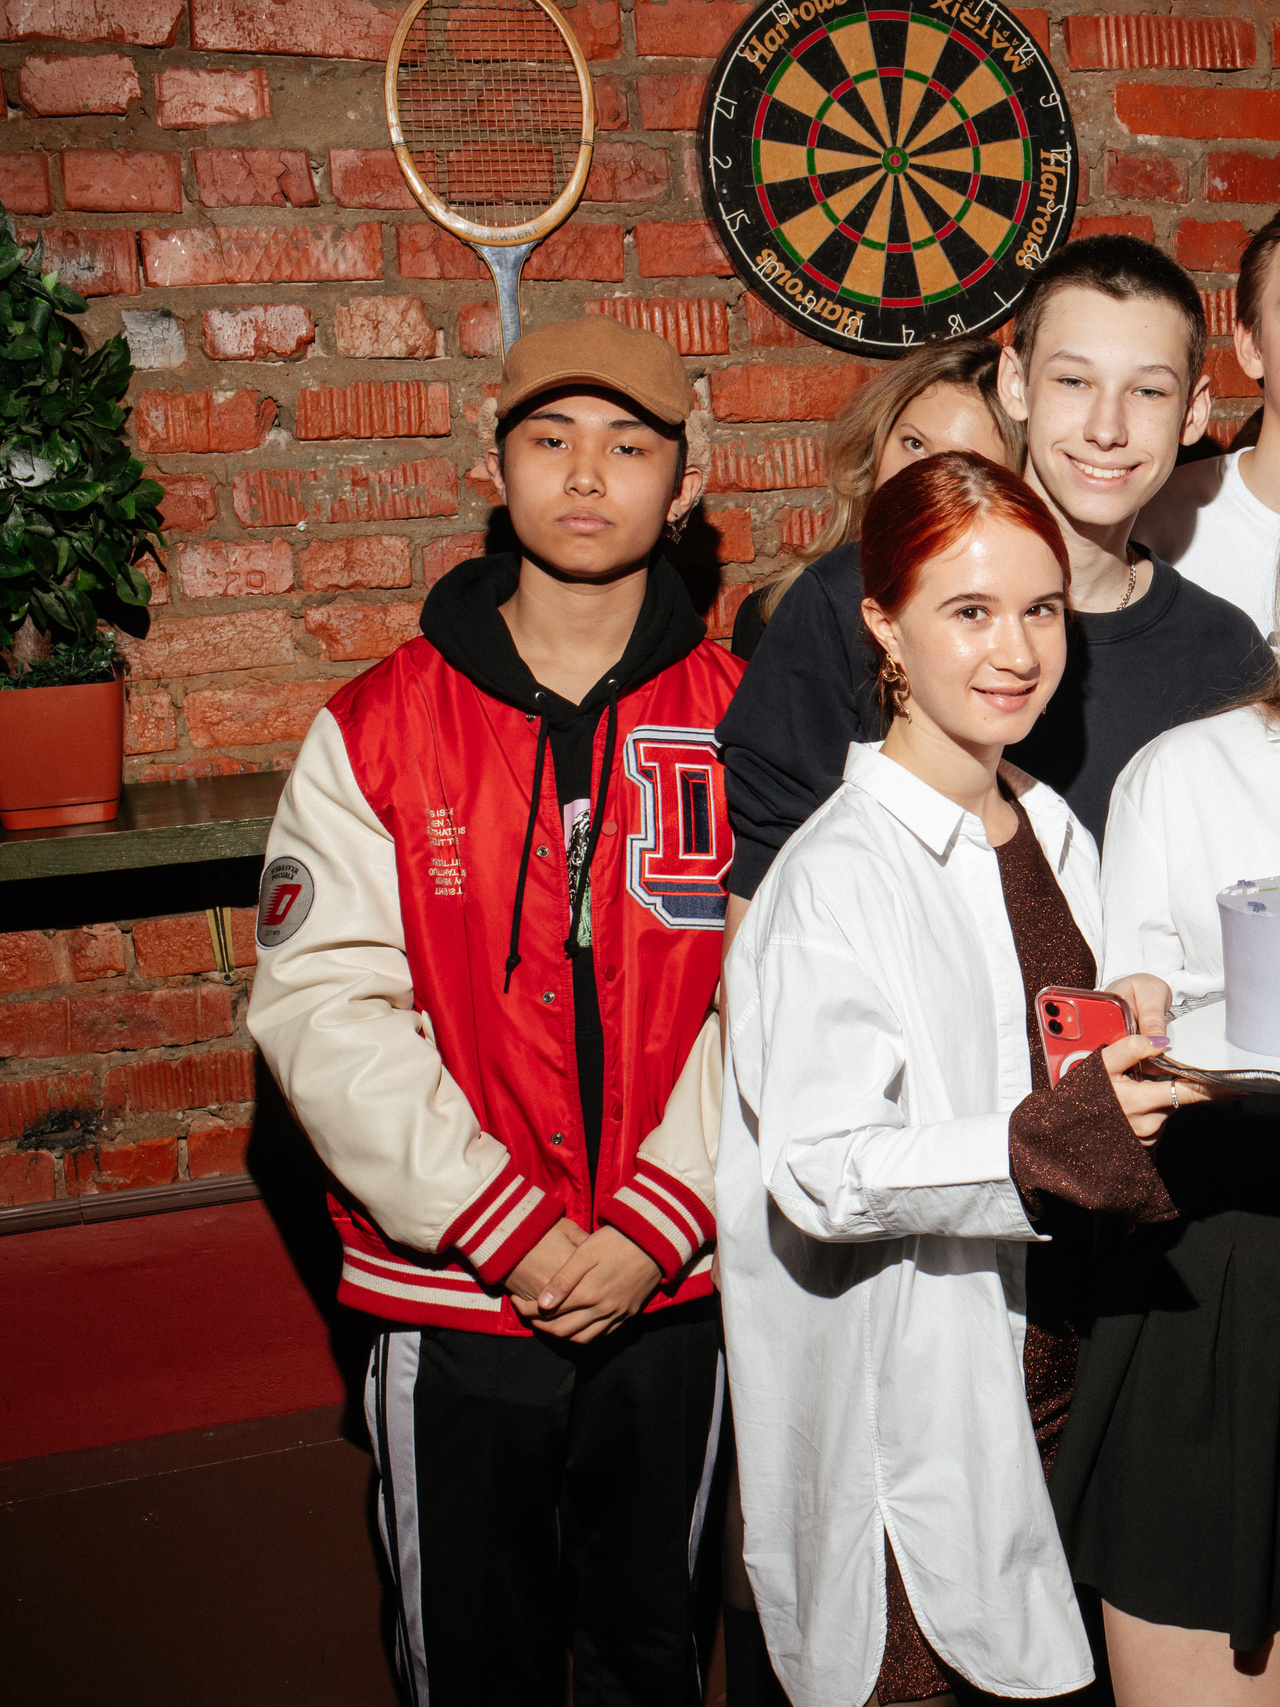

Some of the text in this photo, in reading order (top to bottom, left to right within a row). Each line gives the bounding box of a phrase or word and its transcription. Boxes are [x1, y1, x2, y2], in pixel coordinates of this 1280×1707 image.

[743, 0, 850, 74] Harrow
[929, 0, 1027, 73] MATRIX
[714, 92, 738, 119] 17
[709, 155, 732, 169] 2
[722, 208, 751, 232] 15
[1015, 148, 1067, 270] Harrows
[755, 248, 867, 336] Harrows
[901, 323, 916, 347] 4
[629, 735, 738, 898] D
[260, 884, 303, 926] D
